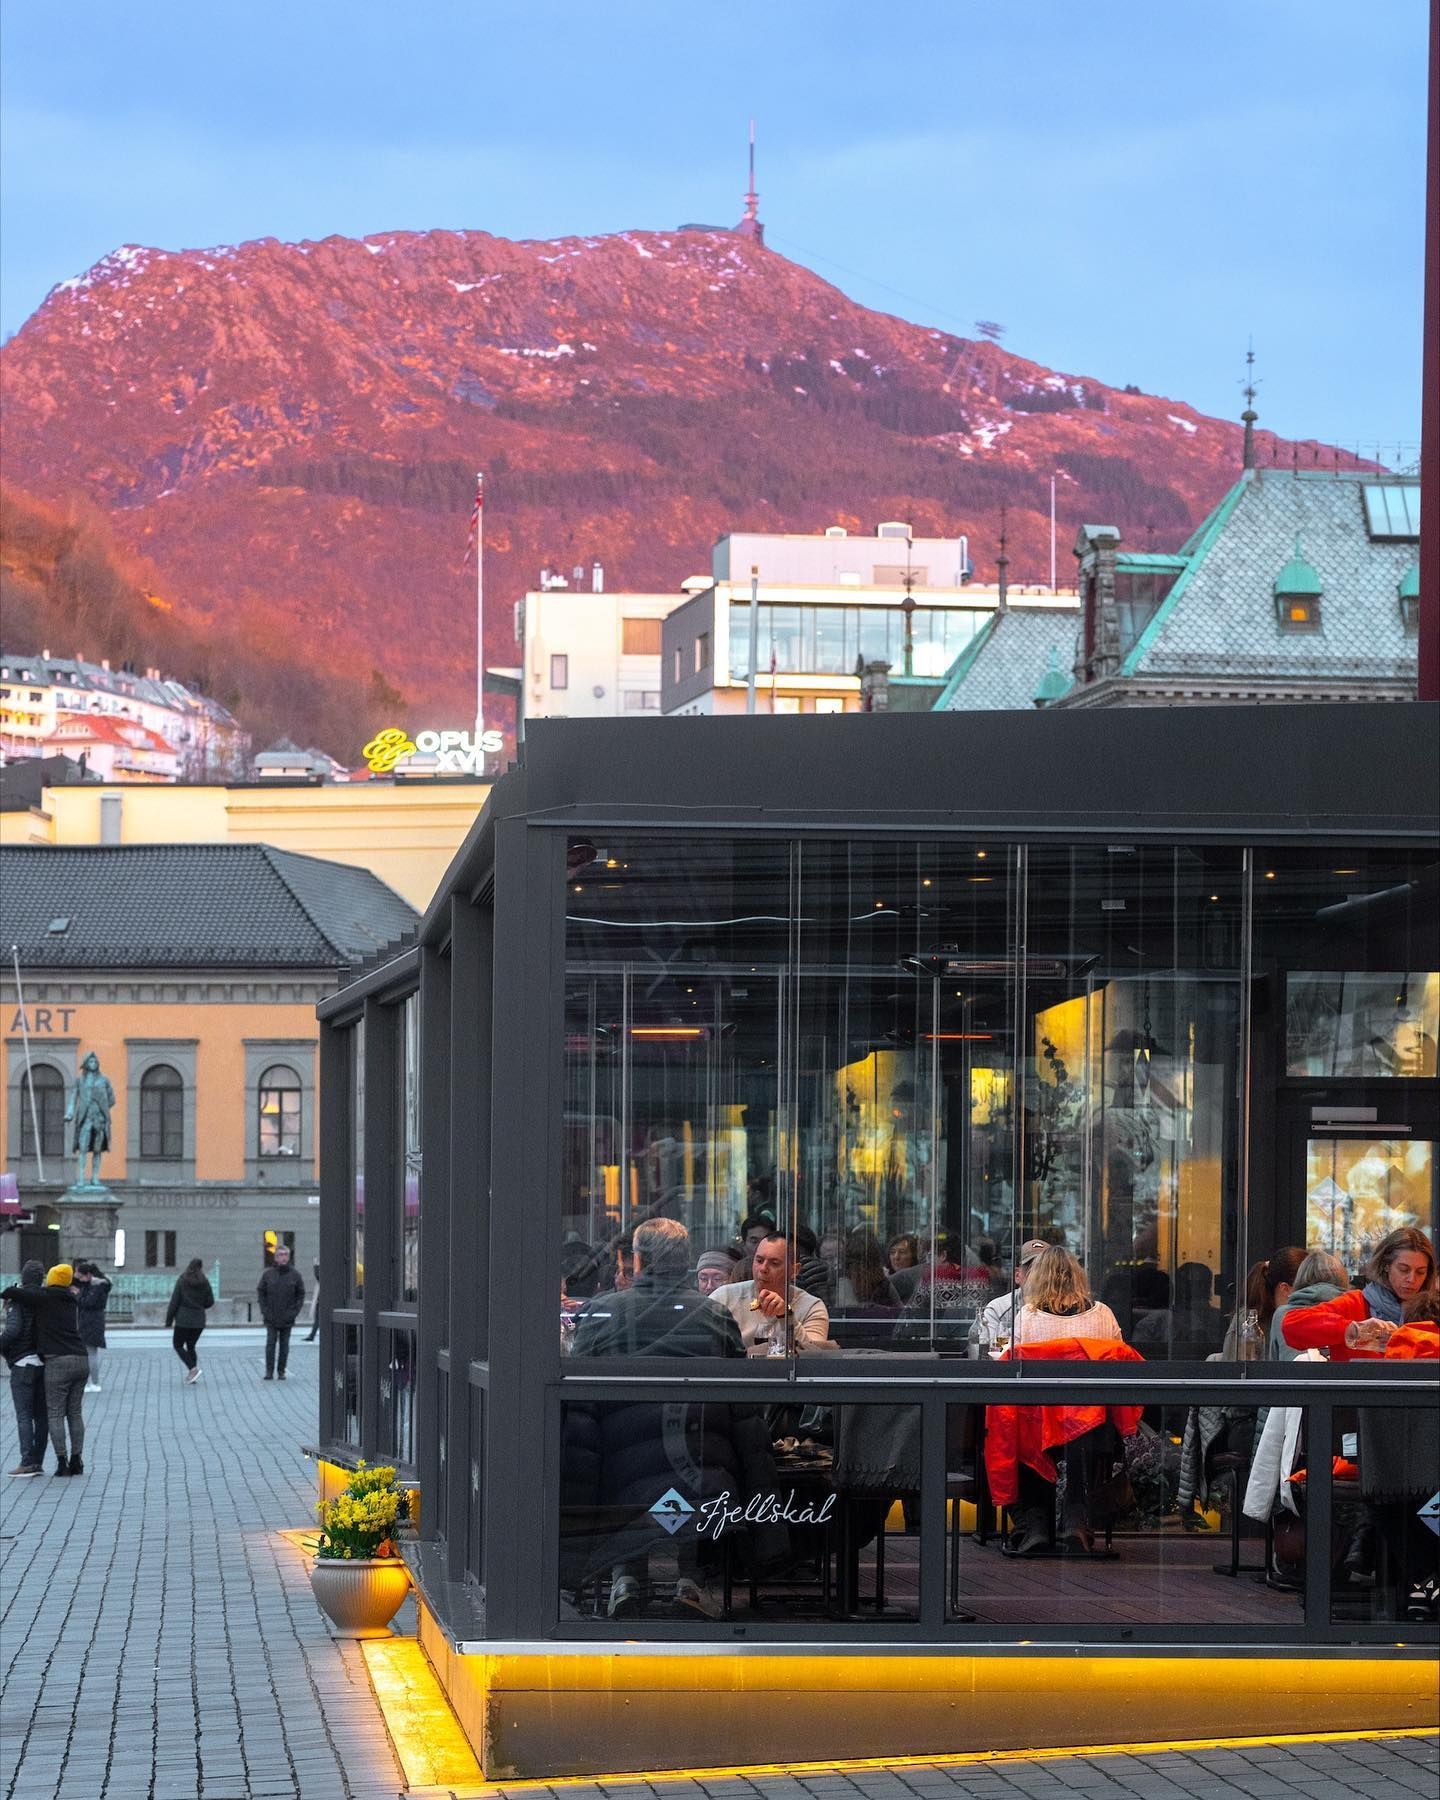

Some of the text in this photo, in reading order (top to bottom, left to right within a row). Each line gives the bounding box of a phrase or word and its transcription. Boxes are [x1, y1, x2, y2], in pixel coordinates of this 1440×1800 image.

[415, 730, 504, 752] OPUS
[434, 750, 485, 773] XVI
[10, 1008, 77, 1032] ART
[136, 1193, 240, 1208] EXHIBITIONS
[696, 1488, 837, 1540] Fjellskål
